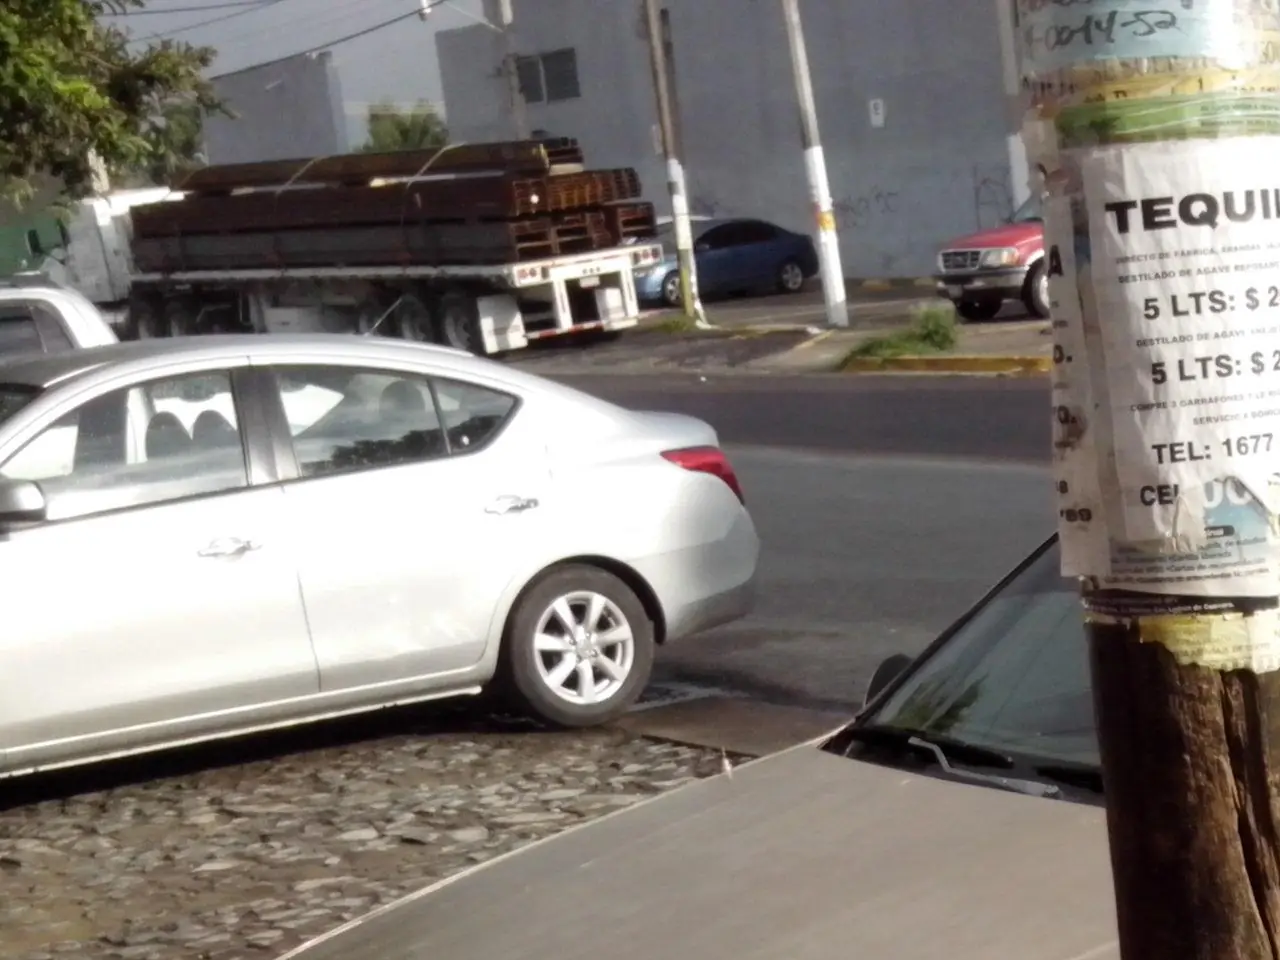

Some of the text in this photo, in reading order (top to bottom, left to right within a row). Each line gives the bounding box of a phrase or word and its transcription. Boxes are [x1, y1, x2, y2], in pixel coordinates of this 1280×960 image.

[1179, 268, 1192, 277] DE
[1196, 265, 1230, 276] AGAVE
[1143, 297, 1161, 320] 5
[1171, 290, 1236, 318] LTS:
[1245, 287, 1260, 311] $
[1196, 332, 1210, 341] DE
[1151, 362, 1168, 385] 5
[1178, 354, 1242, 381] LTS:
[1251, 351, 1265, 375] $
[1152, 441, 1212, 464] TEL:
[1222, 433, 1273, 458] 1677
